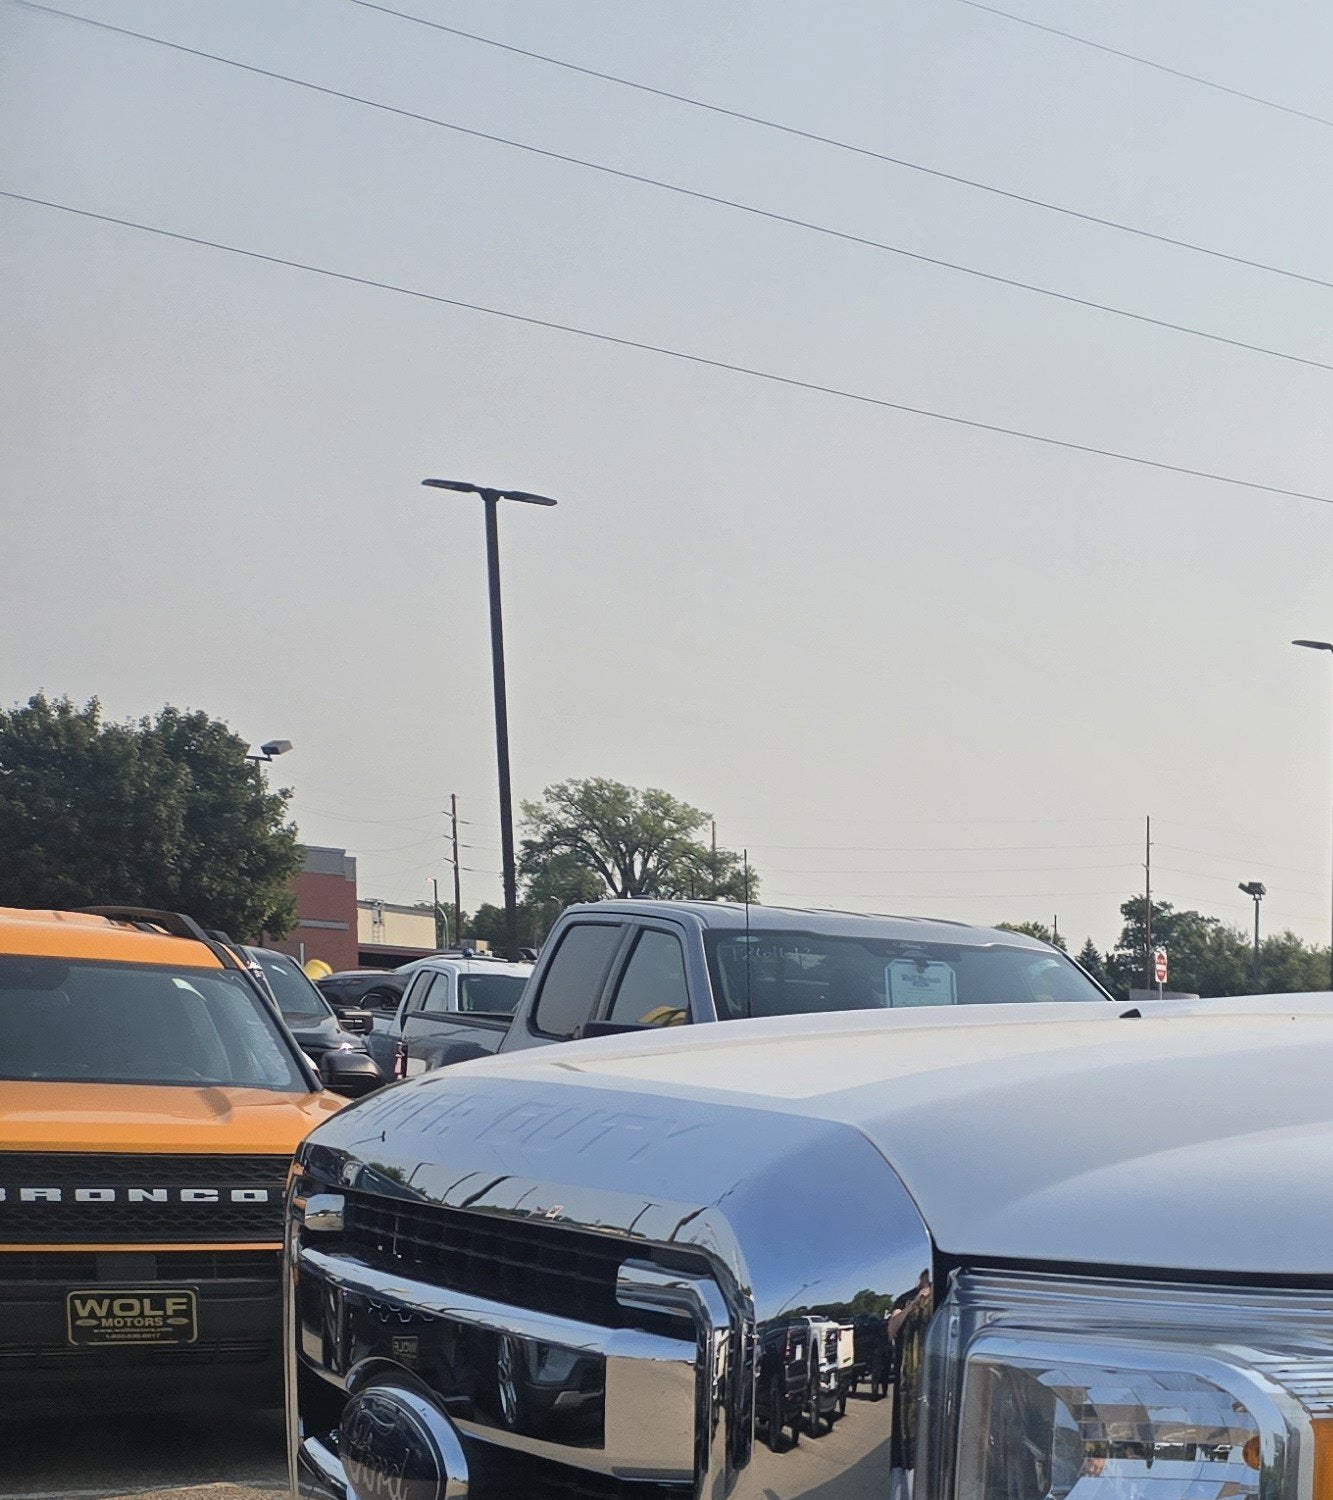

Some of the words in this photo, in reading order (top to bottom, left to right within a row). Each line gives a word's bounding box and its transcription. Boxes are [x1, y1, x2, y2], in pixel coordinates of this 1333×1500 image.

[0, 1187, 268, 1202] RONCO
[74, 1298, 187, 1316] WOLF
[101, 1317, 163, 1327] MOTORS
